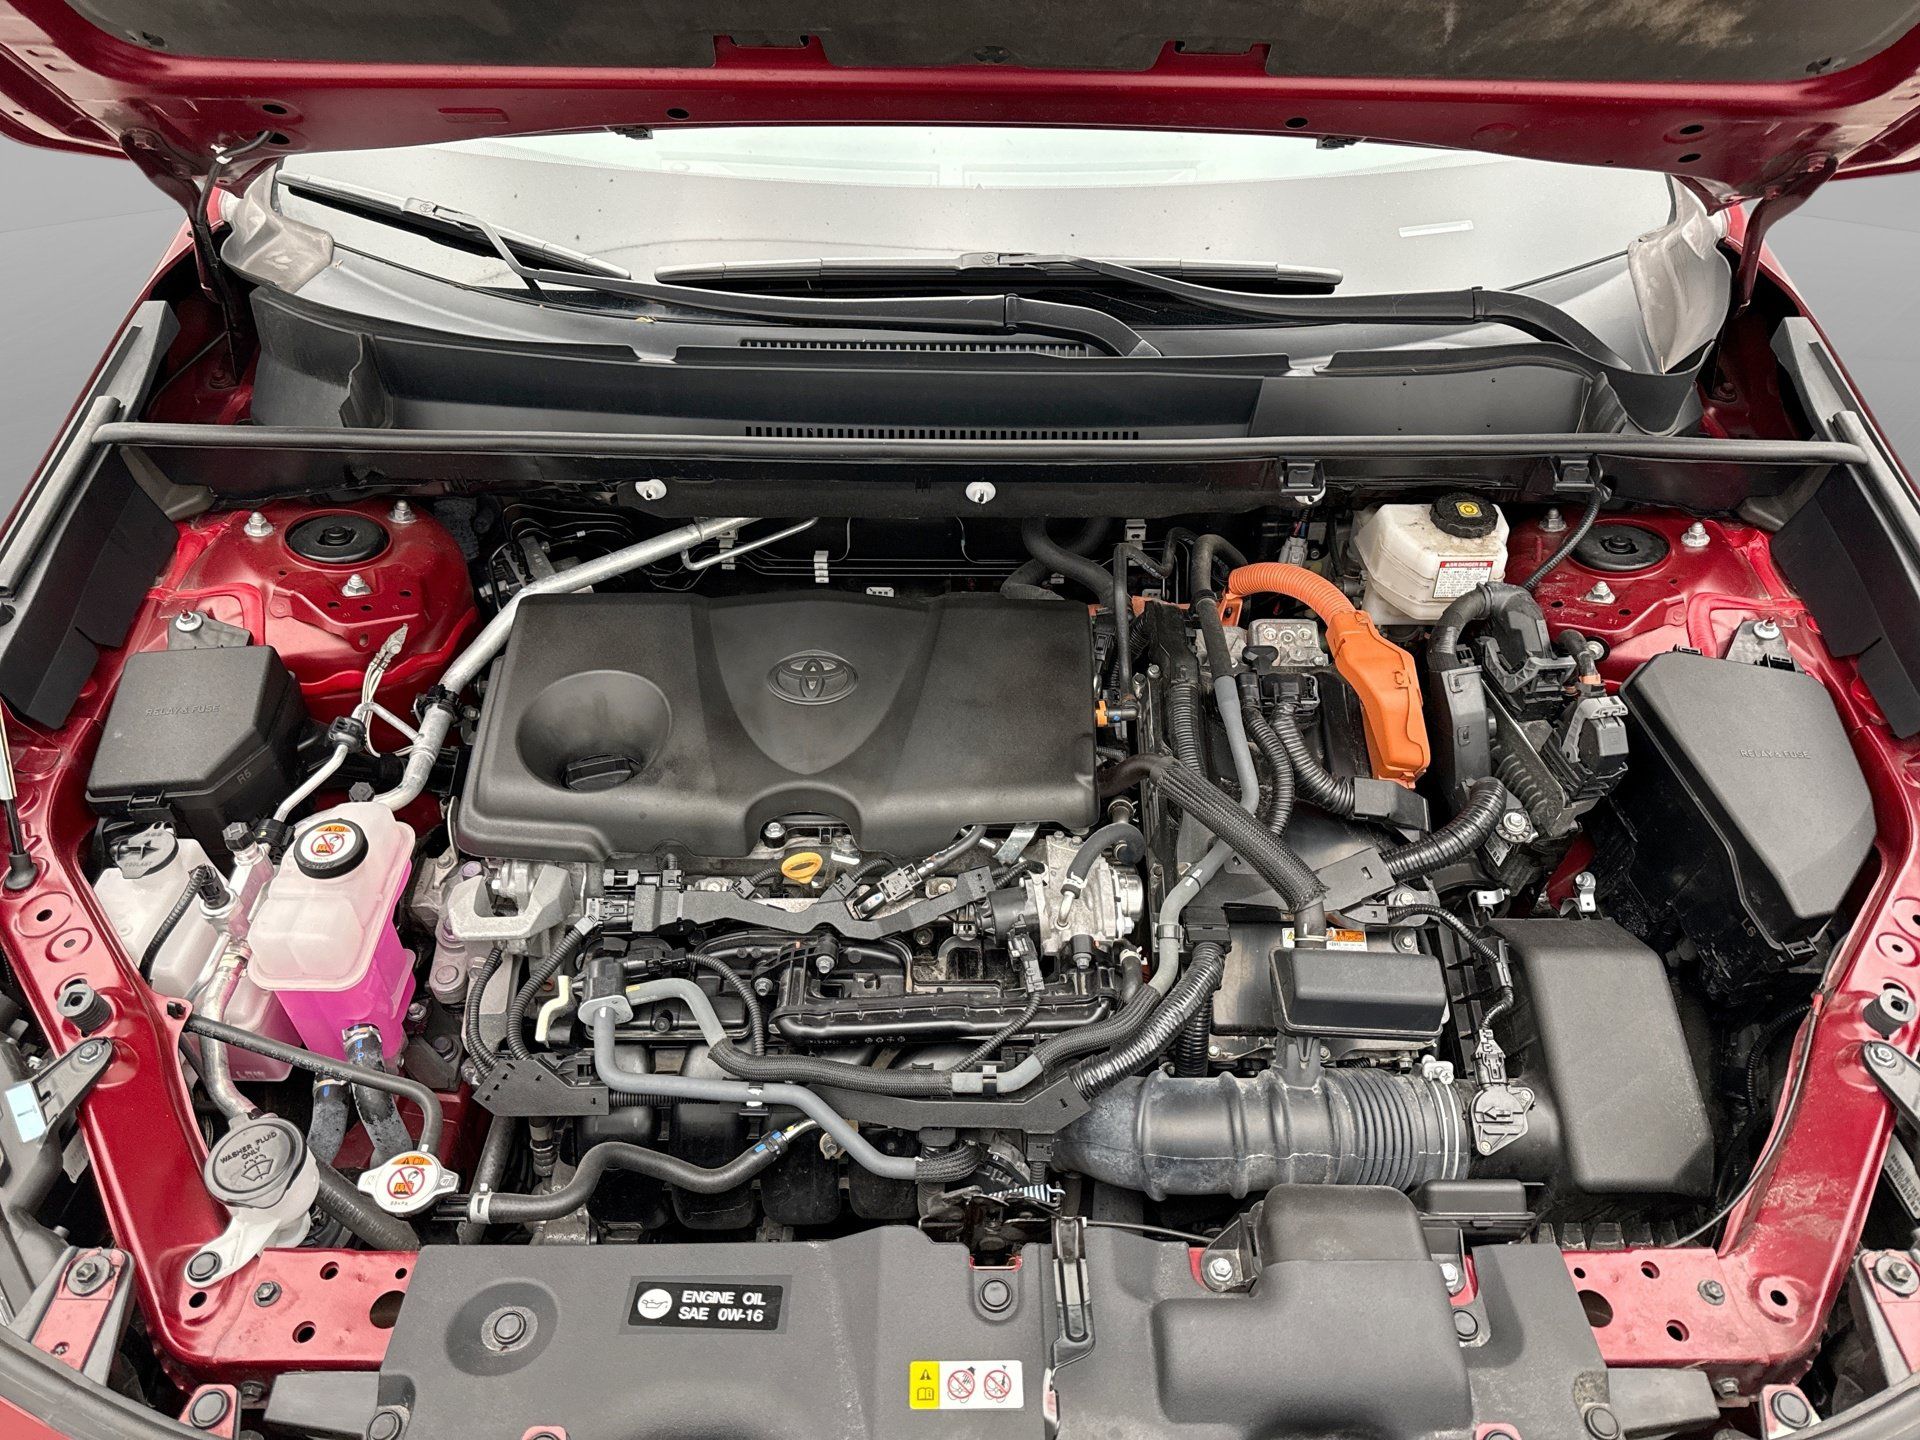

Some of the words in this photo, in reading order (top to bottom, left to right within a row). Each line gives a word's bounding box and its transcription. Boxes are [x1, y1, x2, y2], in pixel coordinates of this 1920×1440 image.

[191, 704, 220, 713] FUSE
[1783, 750, 1811, 759] FUSE
[220, 1144, 253, 1164] WASHER
[255, 1131, 277, 1146] FLUID
[241, 1147, 261, 1160] ONLY
[681, 1290, 735, 1305] ENGINE
[742, 1292, 766, 1306] OIL
[678, 1307, 709, 1321] SAE
[717, 1308, 764, 1323] 0W-16
